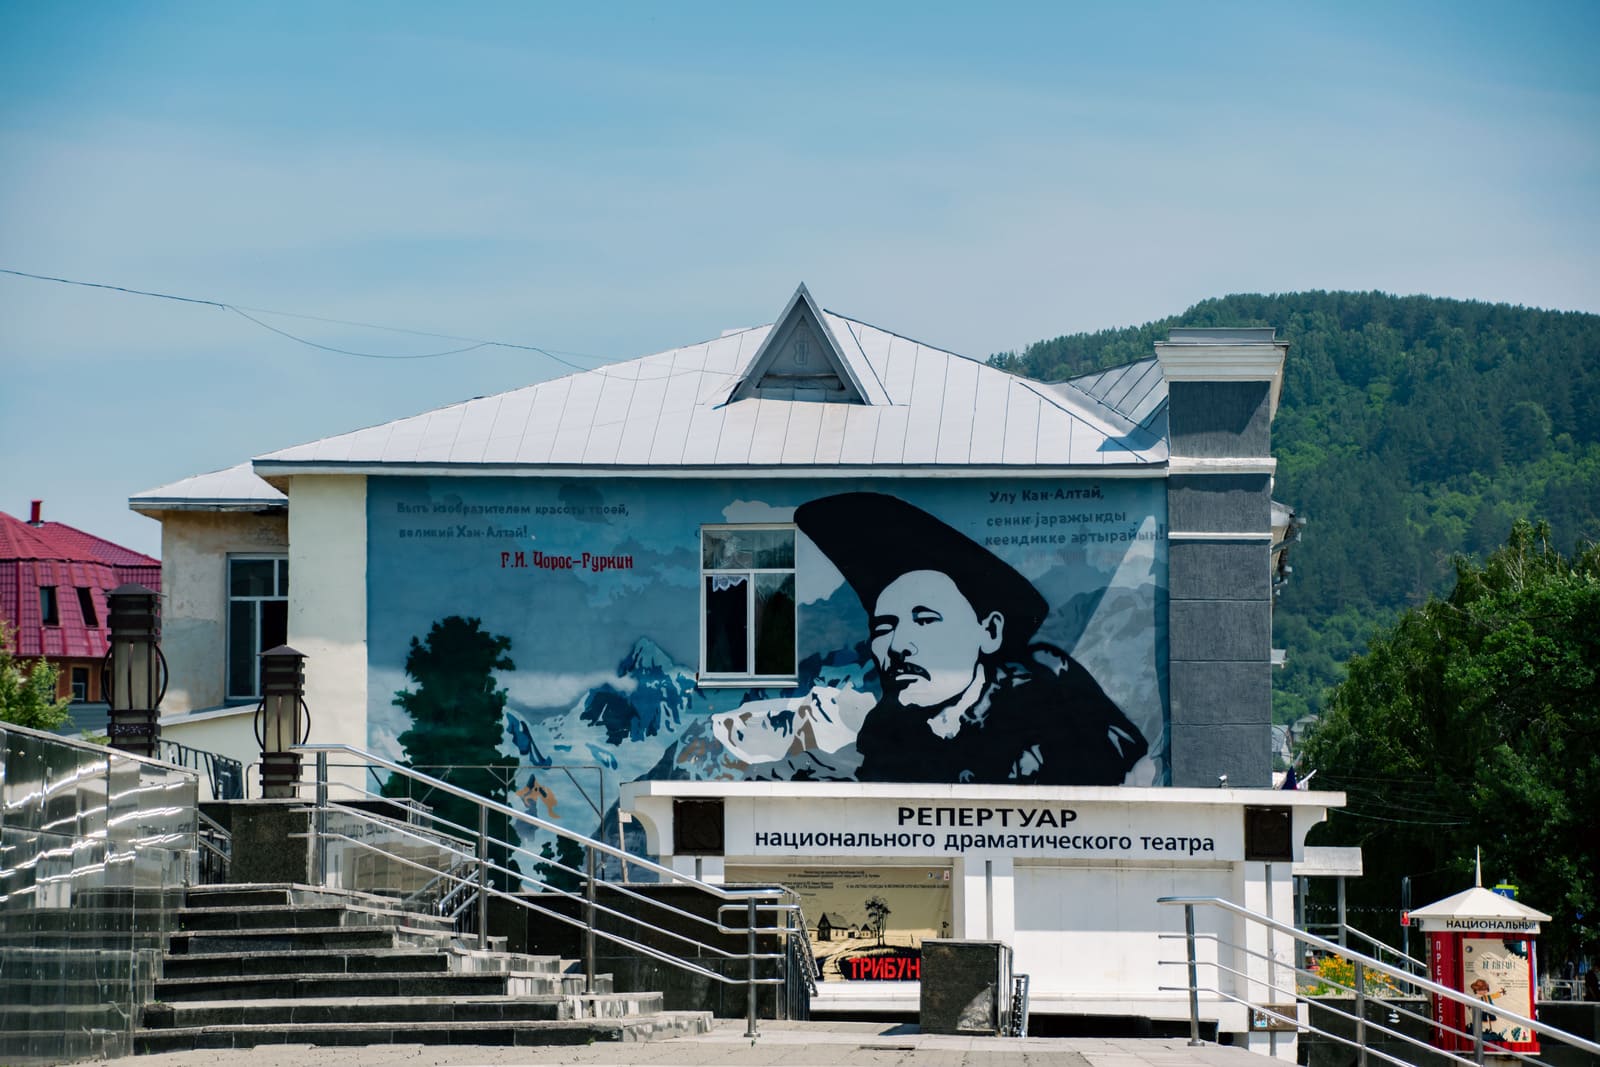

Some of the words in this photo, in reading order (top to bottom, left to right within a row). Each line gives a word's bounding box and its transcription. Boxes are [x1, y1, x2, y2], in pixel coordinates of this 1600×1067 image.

[989, 490, 1017, 505] Улу
[1021, 485, 1105, 502] Кан-Алтай,
[396, 501, 429, 513] Быть
[432, 502, 530, 517] изобразителем
[535, 505, 585, 516] красоты
[399, 526, 454, 538] великий
[456, 524, 528, 538] Хан-Алтай!
[500, 551, 528, 568] Г.И.
[897, 806, 1078, 829] РЕПЕРТУАР
[754, 830, 936, 849] национального
[944, 832, 1133, 852] драматического
[1140, 834, 1215, 854] театра
